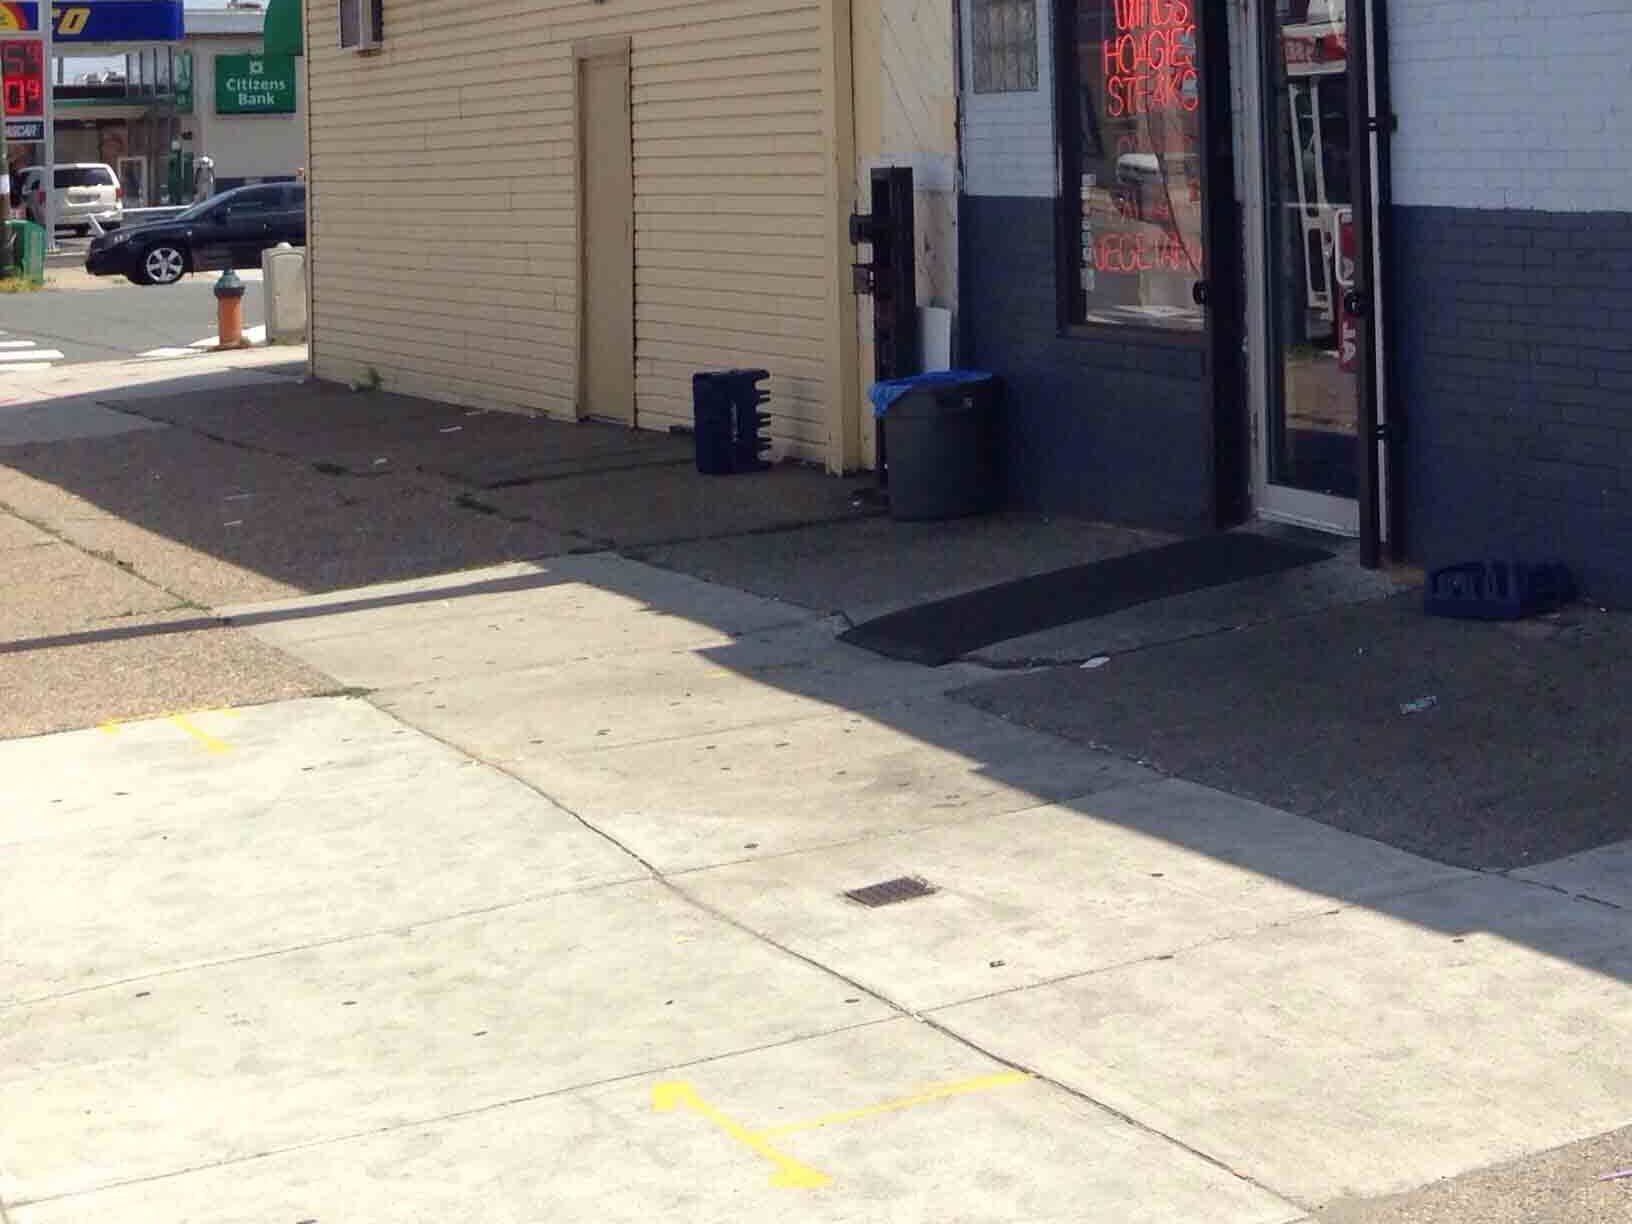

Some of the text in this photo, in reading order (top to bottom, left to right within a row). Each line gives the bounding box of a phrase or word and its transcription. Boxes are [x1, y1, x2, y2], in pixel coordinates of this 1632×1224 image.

[225, 77, 287, 92] Citizens
[238, 91, 275, 106] Bank
[1108, 69, 1199, 117] STEAKS
